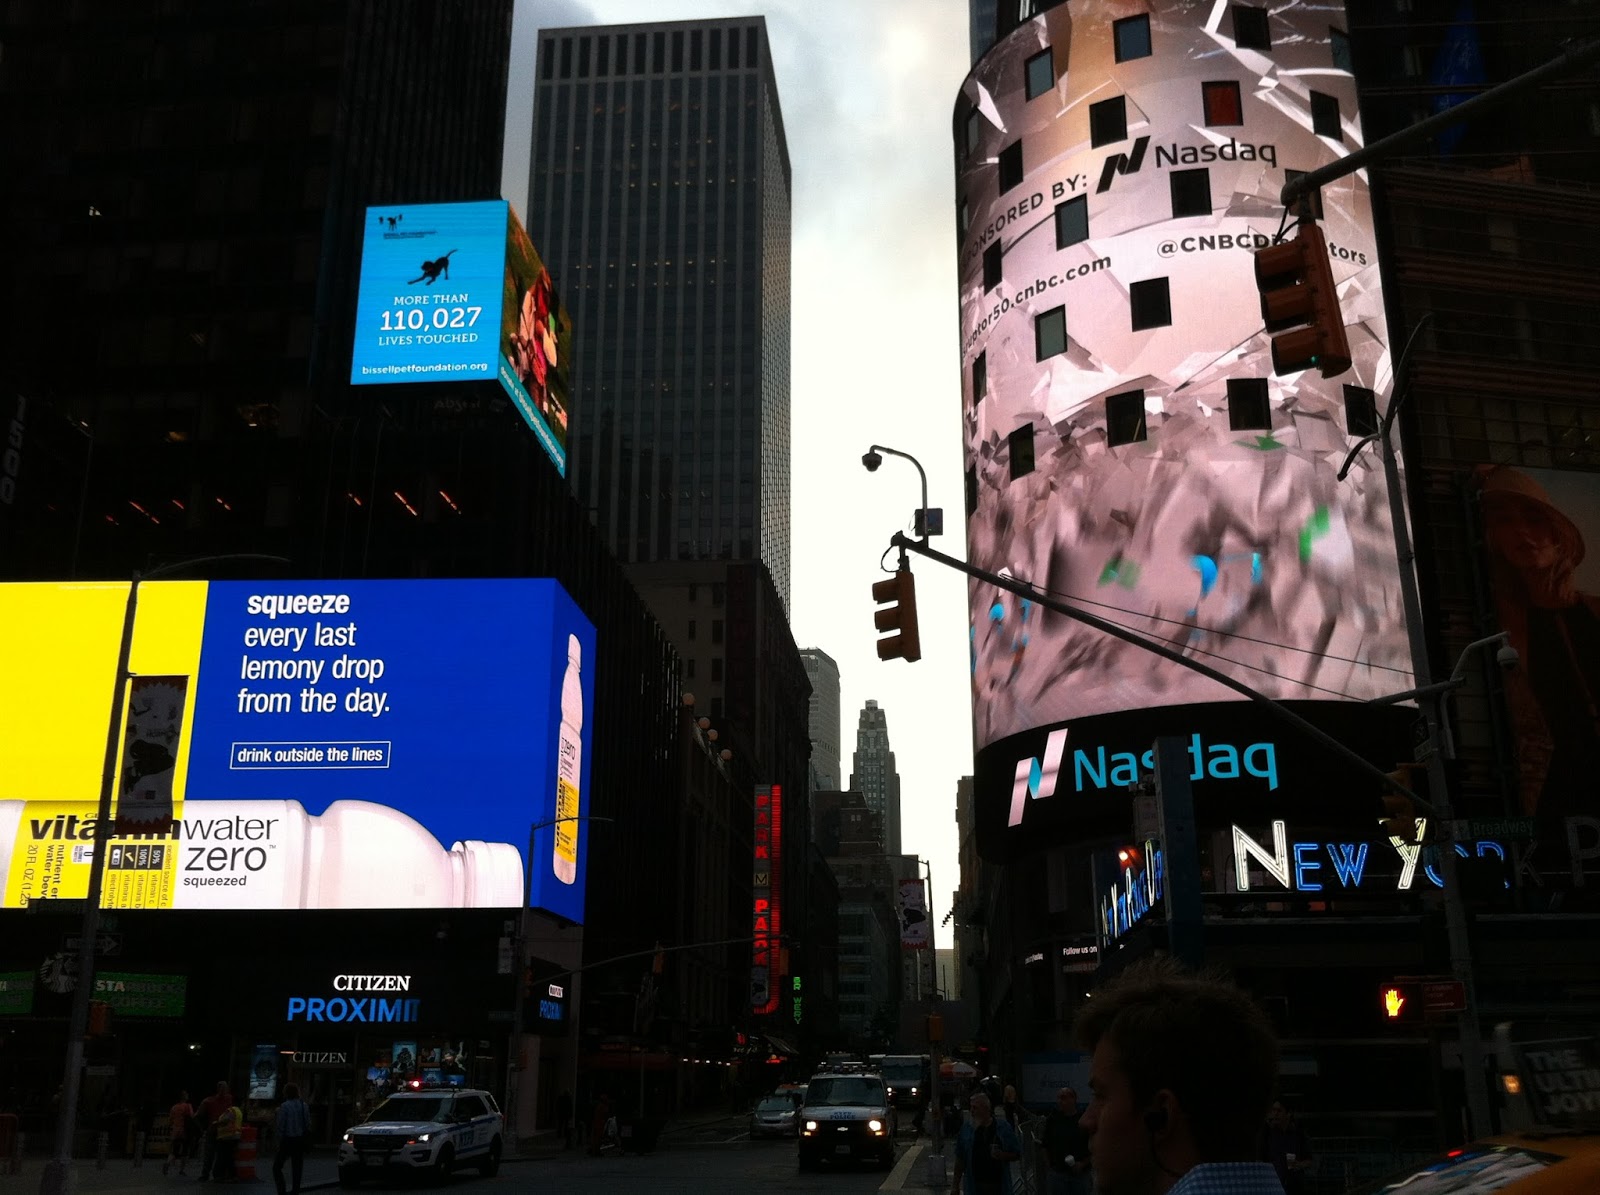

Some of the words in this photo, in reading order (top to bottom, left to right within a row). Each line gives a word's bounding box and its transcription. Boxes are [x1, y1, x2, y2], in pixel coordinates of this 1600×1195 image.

[1155, 137, 1278, 168] Nasdaq
[966, 192, 1044, 262] ONSORED
[1052, 174, 1088, 199] BY:
[1157, 233, 1367, 266] @CNBCDitors
[394, 295, 429, 305] MORE
[433, 294, 468, 304] THAN
[380, 306, 482, 332] 110,027
[378, 335, 413, 346] LIVES
[416, 333, 478, 345] TOUCHED
[362, 362, 488, 375] bissellpetfoundation.org
[247, 594, 350, 619] squeeze
[244, 627, 308, 652] every
[314, 622, 357, 646] last
[240, 655, 325, 684] lemony
[332, 654, 384, 683] drop
[237, 687, 291, 713] from
[300, 687, 337, 713] the
[345, 687, 390, 717] day.
[237, 748, 271, 762] drink
[274, 747, 323, 762] outside
[327, 747, 348, 761] the
[352, 747, 383, 761] lines
[755, 795, 769, 859] PARK
[1472, 818, 1534, 838] Broadway
[27, 844, 38, 855] 20
[44, 844, 54, 873] water
[138, 849, 148, 866] 100%
[151, 850, 161, 864] 50%
[184, 846, 267, 872] zero
[1231, 819, 1369, 892] NEW
[23, 868, 34, 881] OZ
[53, 844, 65, 884] nutrient
[162, 870, 170, 892] source
[184, 875, 247, 888] squeezed
[755, 899, 769, 966] PARK
[1063, 947, 1081, 956] Follow
[1081, 946, 1089, 954] us
[1089, 946, 1098, 954] on
[333, 974, 411, 991] CITIZEN
[793, 976, 802, 1025] BRWERY
[292, 1051, 347, 1063] CITIZEN
